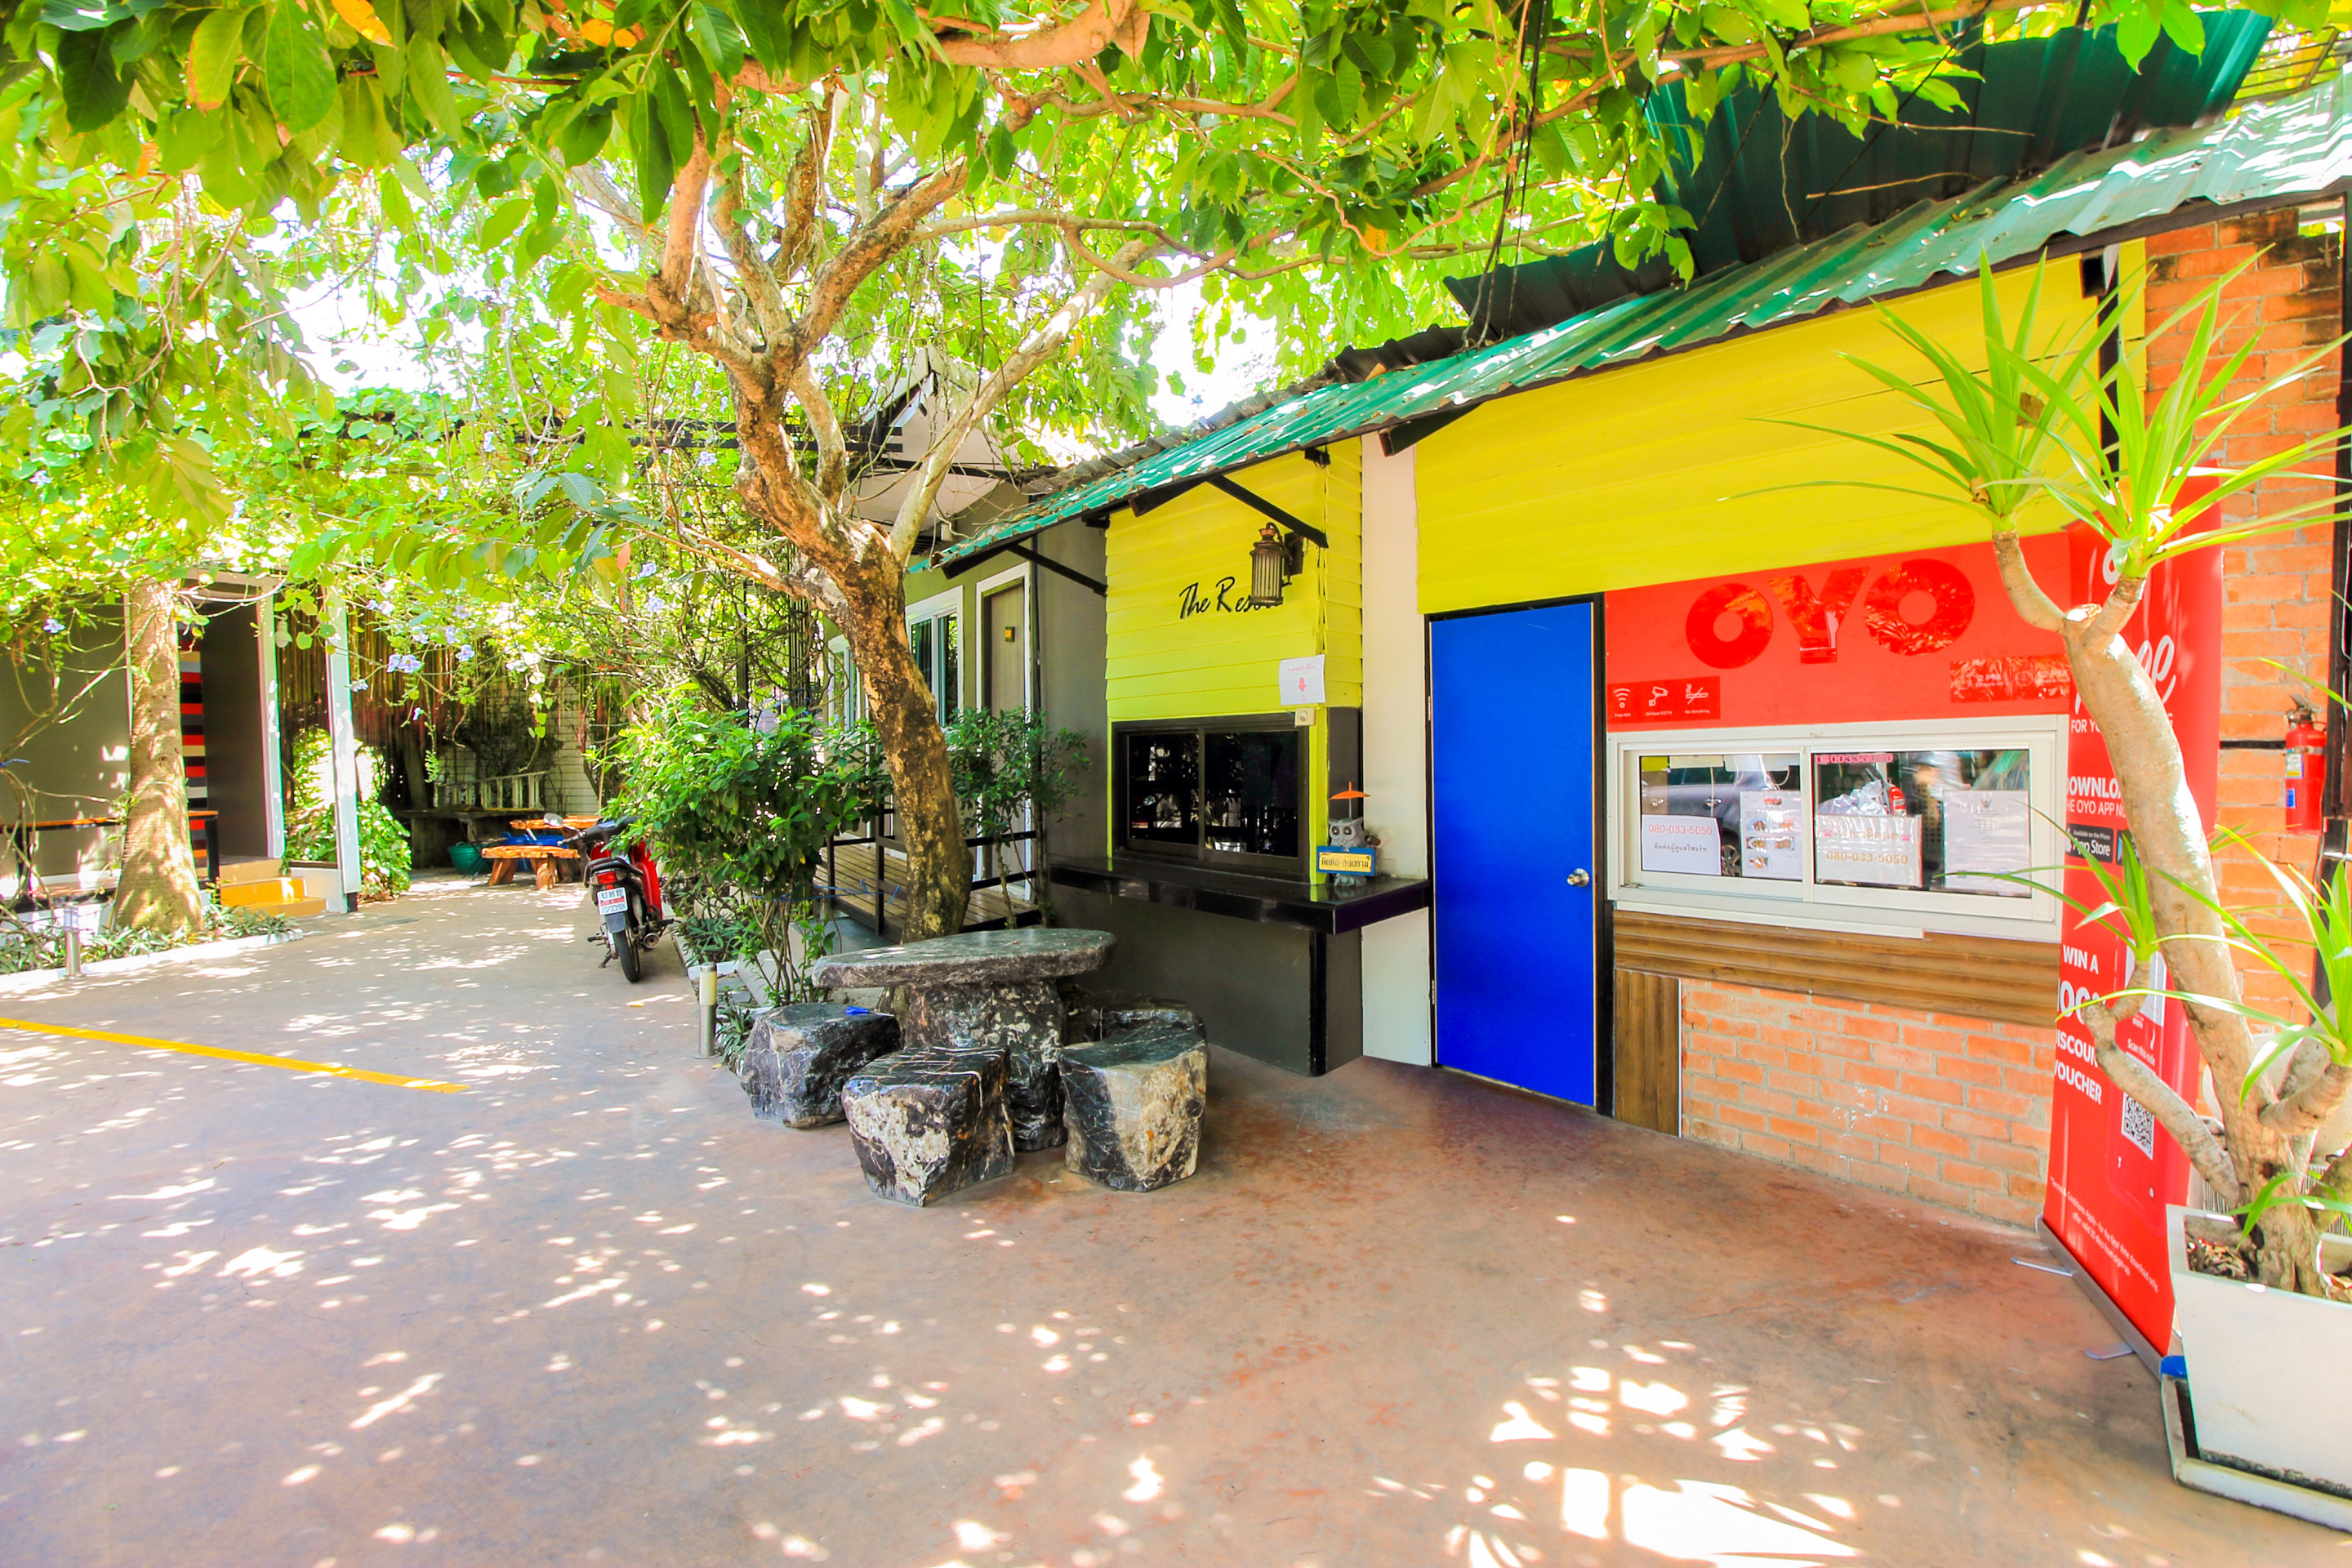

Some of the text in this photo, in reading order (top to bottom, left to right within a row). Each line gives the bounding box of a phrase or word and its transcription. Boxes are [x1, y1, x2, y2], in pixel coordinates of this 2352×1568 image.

[1178, 582, 1210, 619] The
[1686, 559, 1976, 669] OYO
[2071, 719, 2087, 733] FOR
[2077, 800, 2096, 815] OYO
[2097, 801, 2115, 817] APP
[1648, 824, 1713, 835] 080-033-5050
[2091, 839, 2110, 857] Store
[1826, 851, 1909, 865] 080-033-5050
[2063, 944, 2099, 975] WIN A
[2104, 1242, 2114, 1260] from
[2110, 1234, 2119, 1250] first
[2120, 1244, 2130, 1260] time
[2129, 1254, 2149, 1281] download
